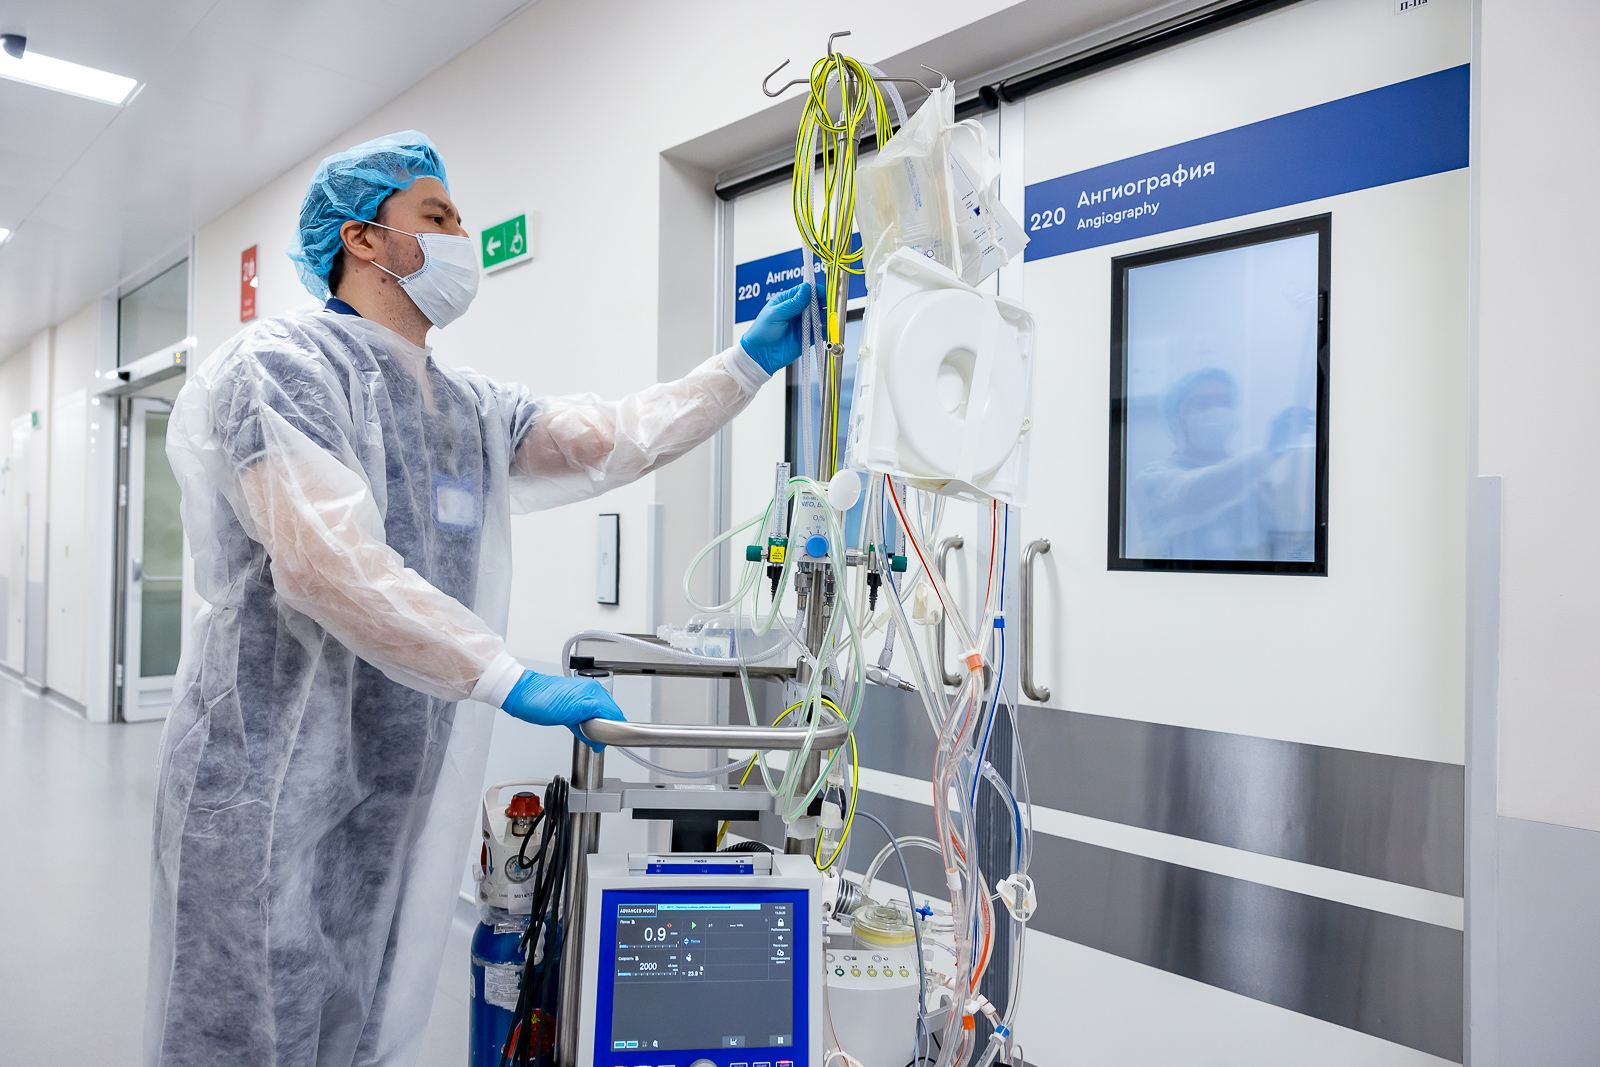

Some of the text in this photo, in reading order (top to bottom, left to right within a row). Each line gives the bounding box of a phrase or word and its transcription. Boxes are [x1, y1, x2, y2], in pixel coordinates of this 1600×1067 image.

[1076, 161, 1216, 209] Ангиография
[1030, 206, 1067, 232] 220
[1076, 201, 1161, 230] Angiography
[738, 282, 761, 301] 220
[644, 927, 667, 942] 0.9
[639, 962, 657, 971] 2000
